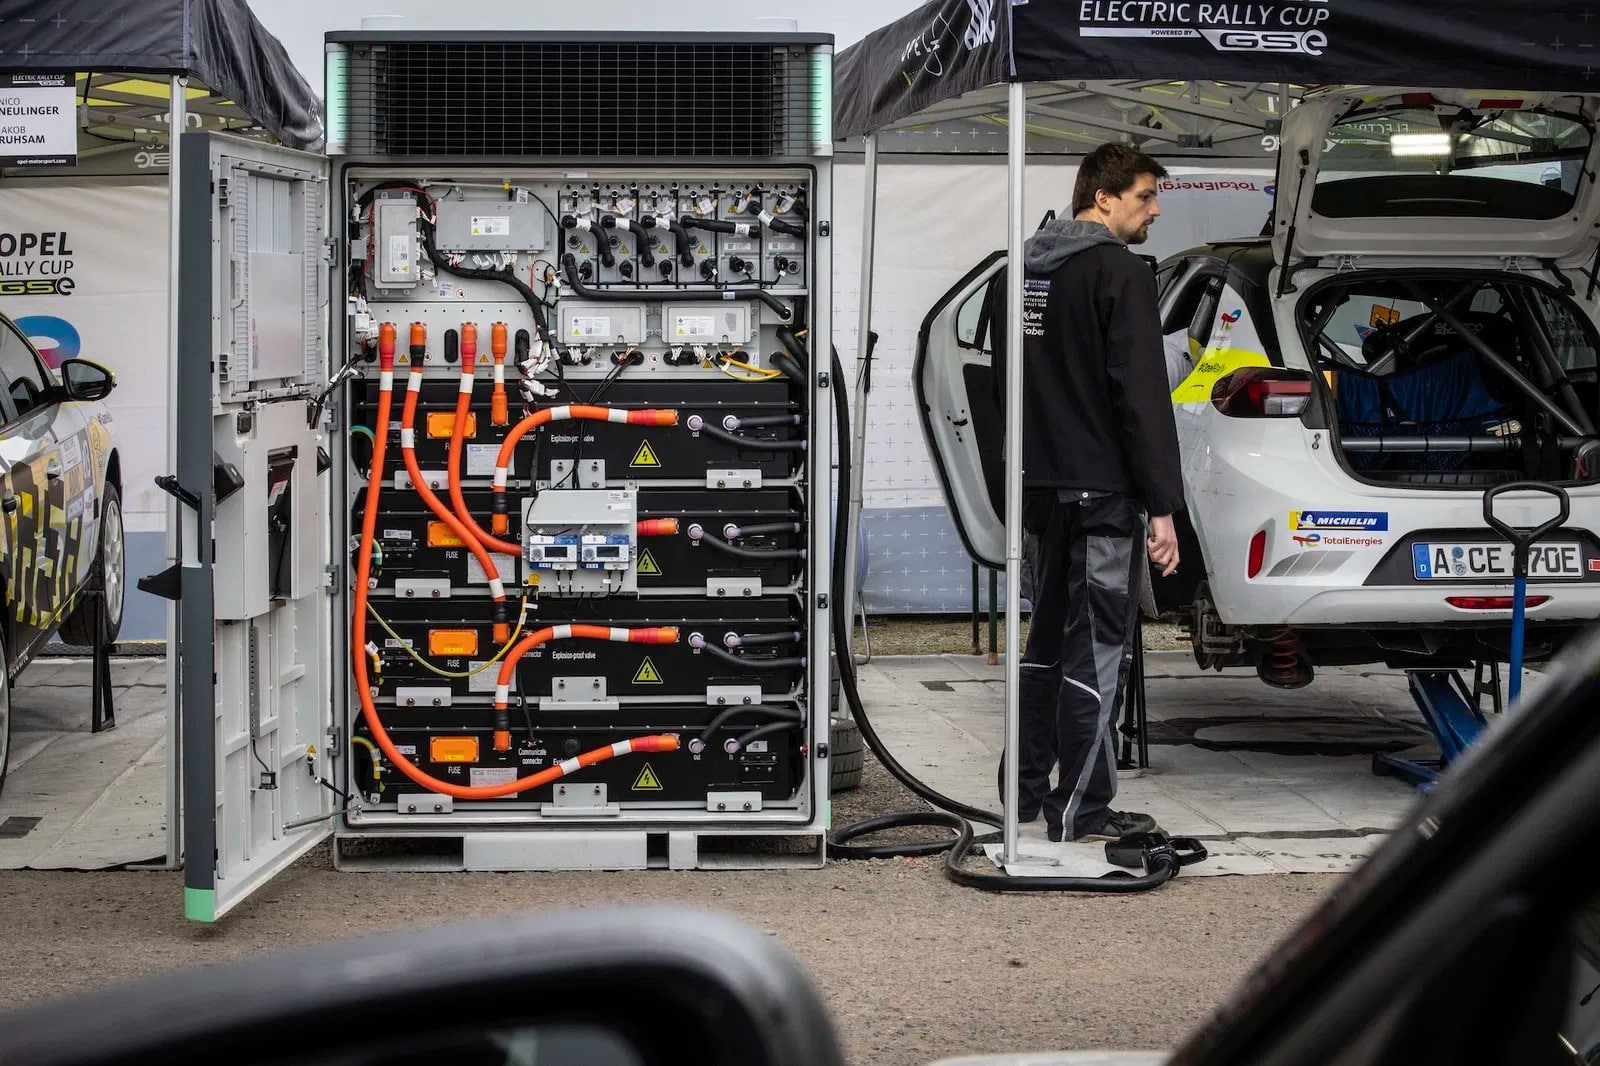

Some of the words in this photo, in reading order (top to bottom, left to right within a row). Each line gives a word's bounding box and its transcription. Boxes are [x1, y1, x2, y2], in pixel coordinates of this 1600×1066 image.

[1079, 1, 1191, 23] ELECTRIC
[1198, 4, 1275, 25] RALLY
[1279, 8, 1330, 26] CUP
[0, 106, 59, 115] NEULINGER
[0, 135, 45, 144] RUHSAM
[1159, 181, 1260, 192] TotalEnergi
[0, 232, 73, 257] OPEL
[40, 260, 74, 275] CUP
[1317, 517, 1378, 526] MICHELIN
[1323, 537, 1383, 547] TotalEnergies
[446, 551, 459, 559] FUSE
[1434, 548, 1450, 574] A
[1469, 547, 1505, 574] CE
[1511, 547, 1579, 573] 70E
[1420, 564, 1427, 572] D
[552, 651, 584, 660] Explosion-proof
[448, 766, 461, 774] FUSE
